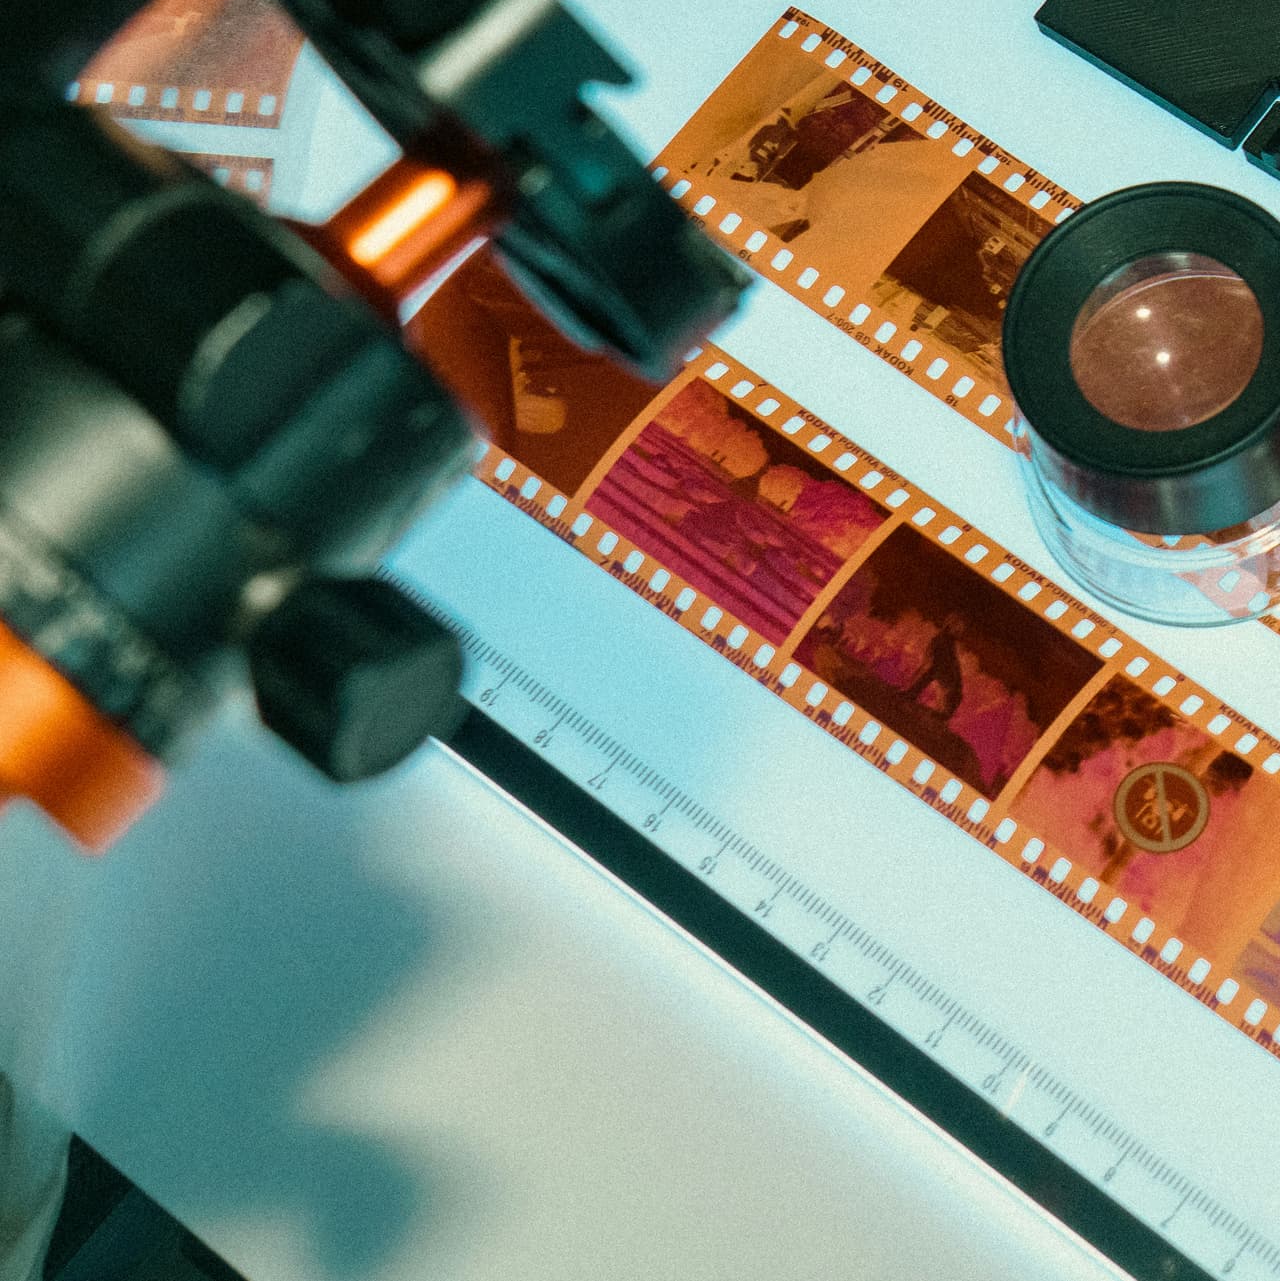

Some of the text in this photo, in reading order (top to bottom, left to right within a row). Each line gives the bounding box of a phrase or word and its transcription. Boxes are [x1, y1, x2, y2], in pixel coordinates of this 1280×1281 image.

[893, 78, 909, 93] 19
[875, 344, 915, 377] KODAK
[797, 408, 880, 469] KODAK PORTRA
[1004, 553, 1088, 615] KODAK PORTRA
[480, 688, 499, 707] 19
[1219, 703, 1260, 735] KODAK
[534, 729, 553, 748] 18
[587, 773, 608, 790] 17
[643, 813, 661, 833] 16
[700, 855, 717, 875] 15
[755, 899, 773, 918] 14
[811, 942, 830, 961] 13
[867, 986, 886, 1005] 12
[925, 1030, 942, 1048] 11
[983, 1073, 1000, 1093] 10
